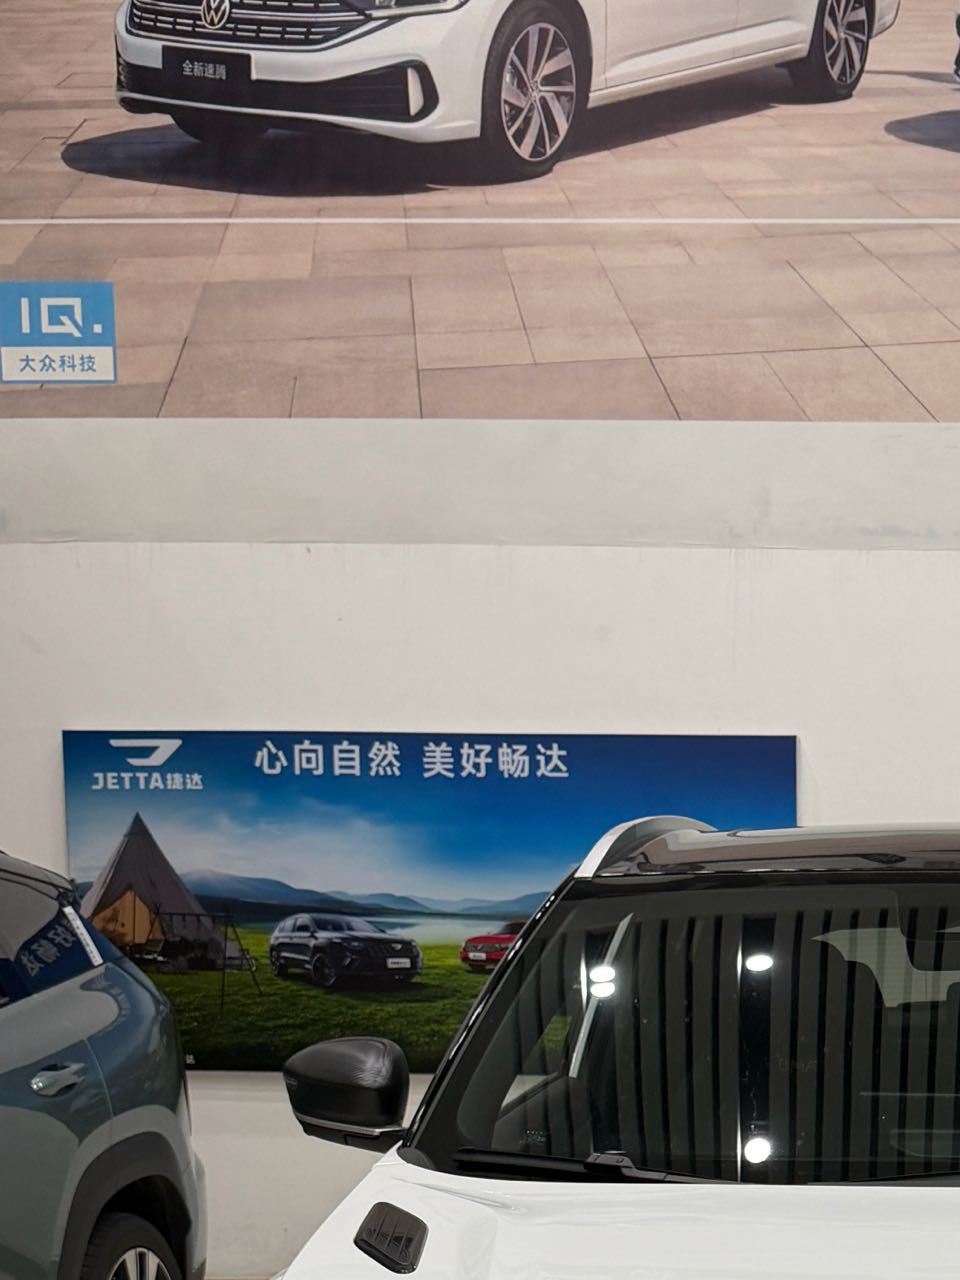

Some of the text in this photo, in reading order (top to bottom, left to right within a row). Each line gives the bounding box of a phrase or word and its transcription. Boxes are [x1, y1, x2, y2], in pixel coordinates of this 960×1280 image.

[182, 59, 227, 81] 全新速腾
[19, 354, 97, 373] 大众科技
[254, 739, 569, 779] 心向自然 美好畅达
